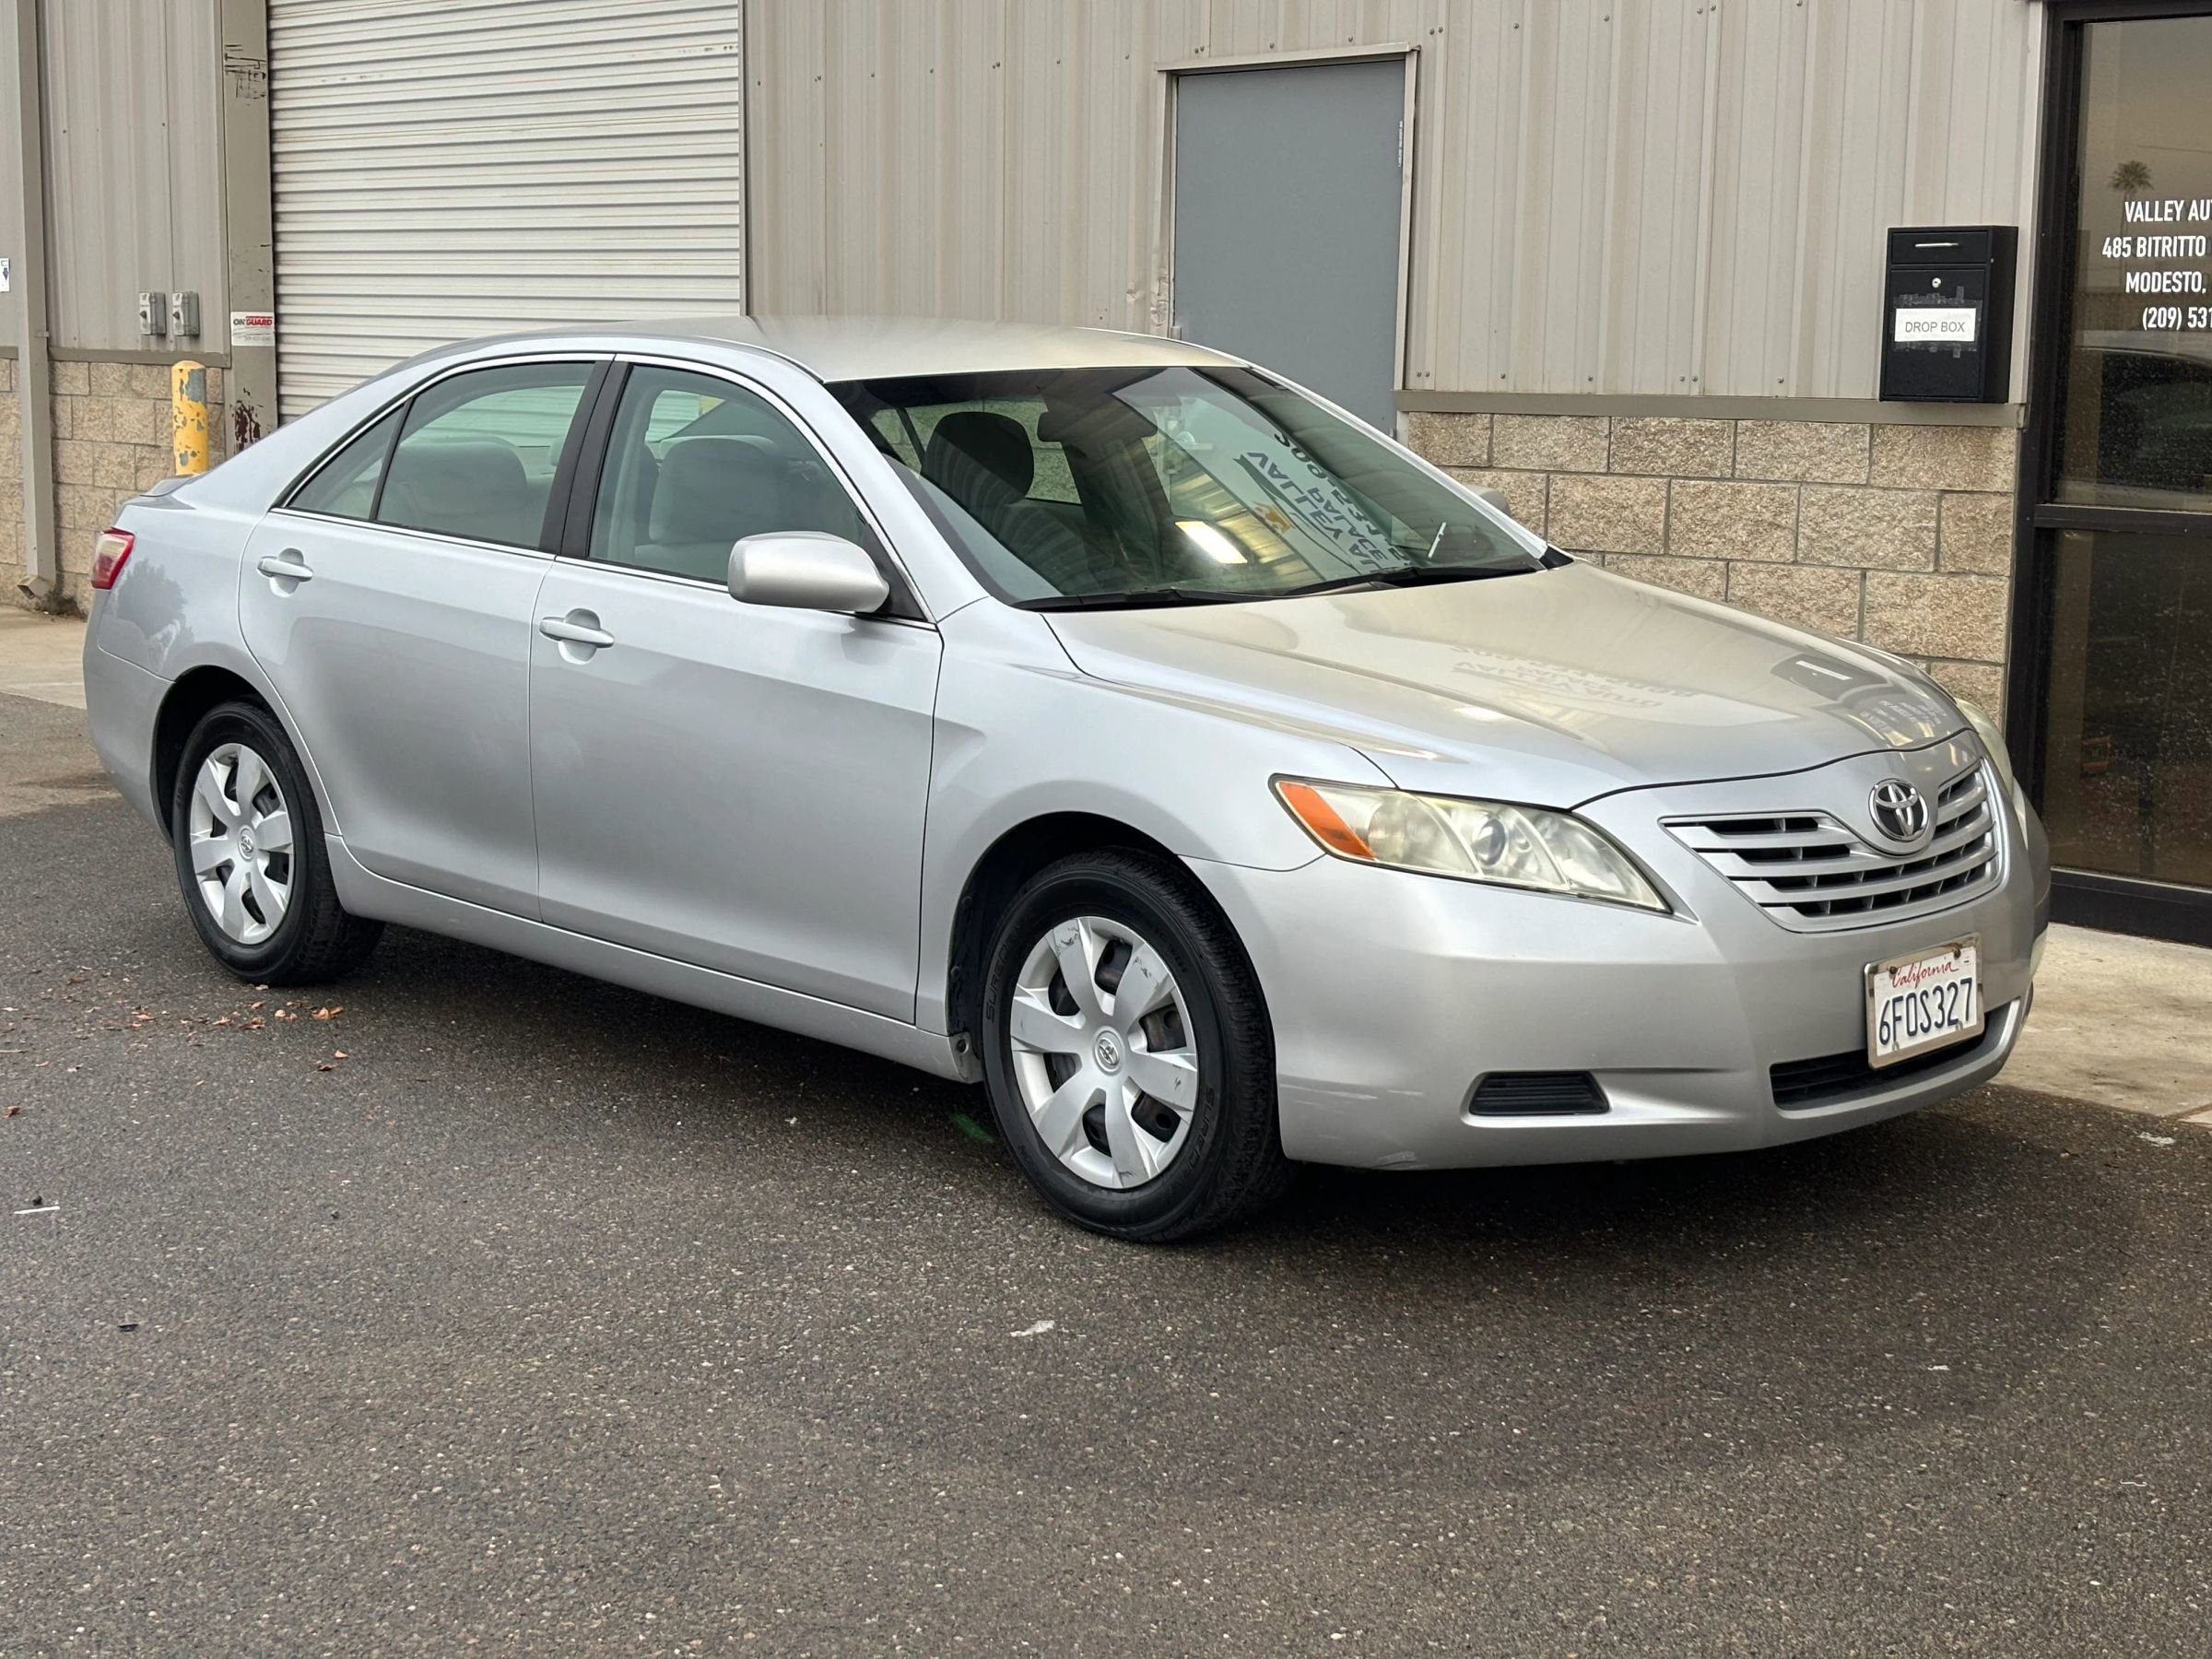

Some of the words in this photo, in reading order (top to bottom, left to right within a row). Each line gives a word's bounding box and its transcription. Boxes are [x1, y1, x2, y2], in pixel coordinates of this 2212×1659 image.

[2124, 200, 2184, 222] VALLEY
[2188, 199, 2212, 221] AU
[2102, 237, 2132, 258] 485
[2136, 235, 2206, 258] BITRITTO
[2125, 271, 2206, 294] MODESTO,
[1905, 322, 1937, 333] DROP
[1940, 322, 1965, 333] BOX
[2142, 307, 2183, 331] (209)
[1891, 958, 1959, 989] California
